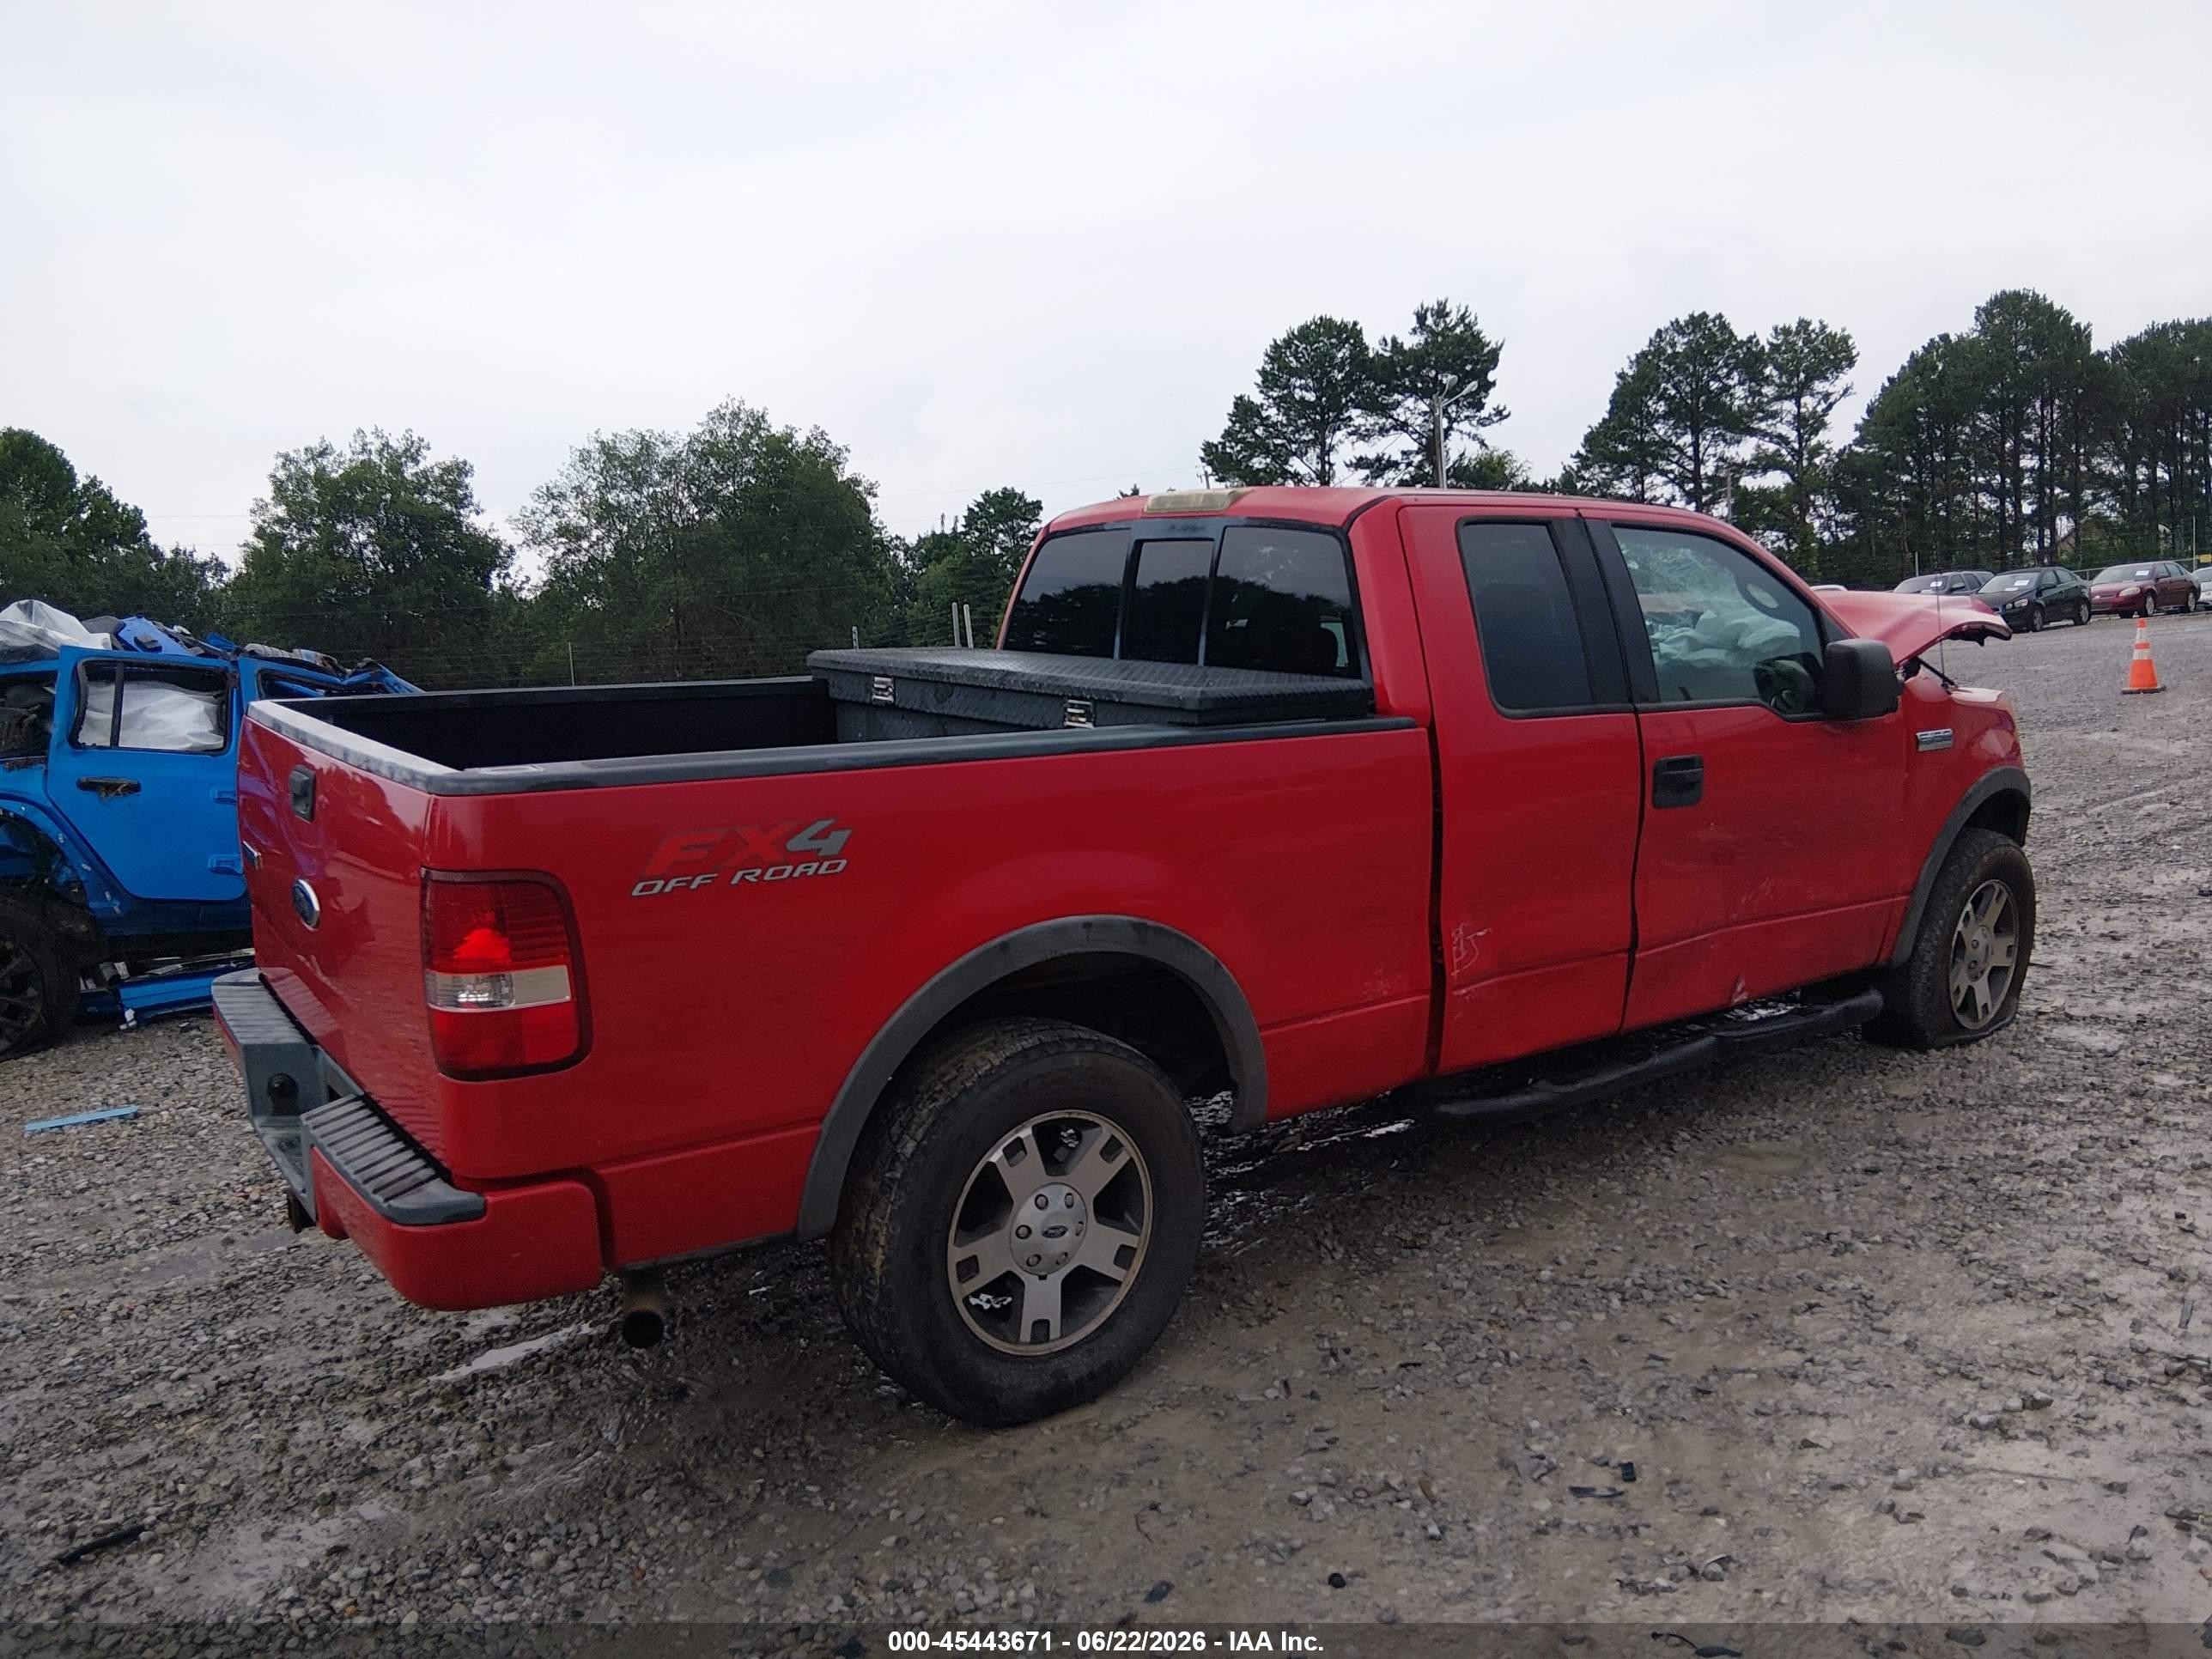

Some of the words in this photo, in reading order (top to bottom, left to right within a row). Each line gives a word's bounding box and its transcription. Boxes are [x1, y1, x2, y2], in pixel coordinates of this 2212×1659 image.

[642, 817, 853, 877] FX4
[631, 872, 718, 896] OFF
[731, 859, 848, 885] ROAD
